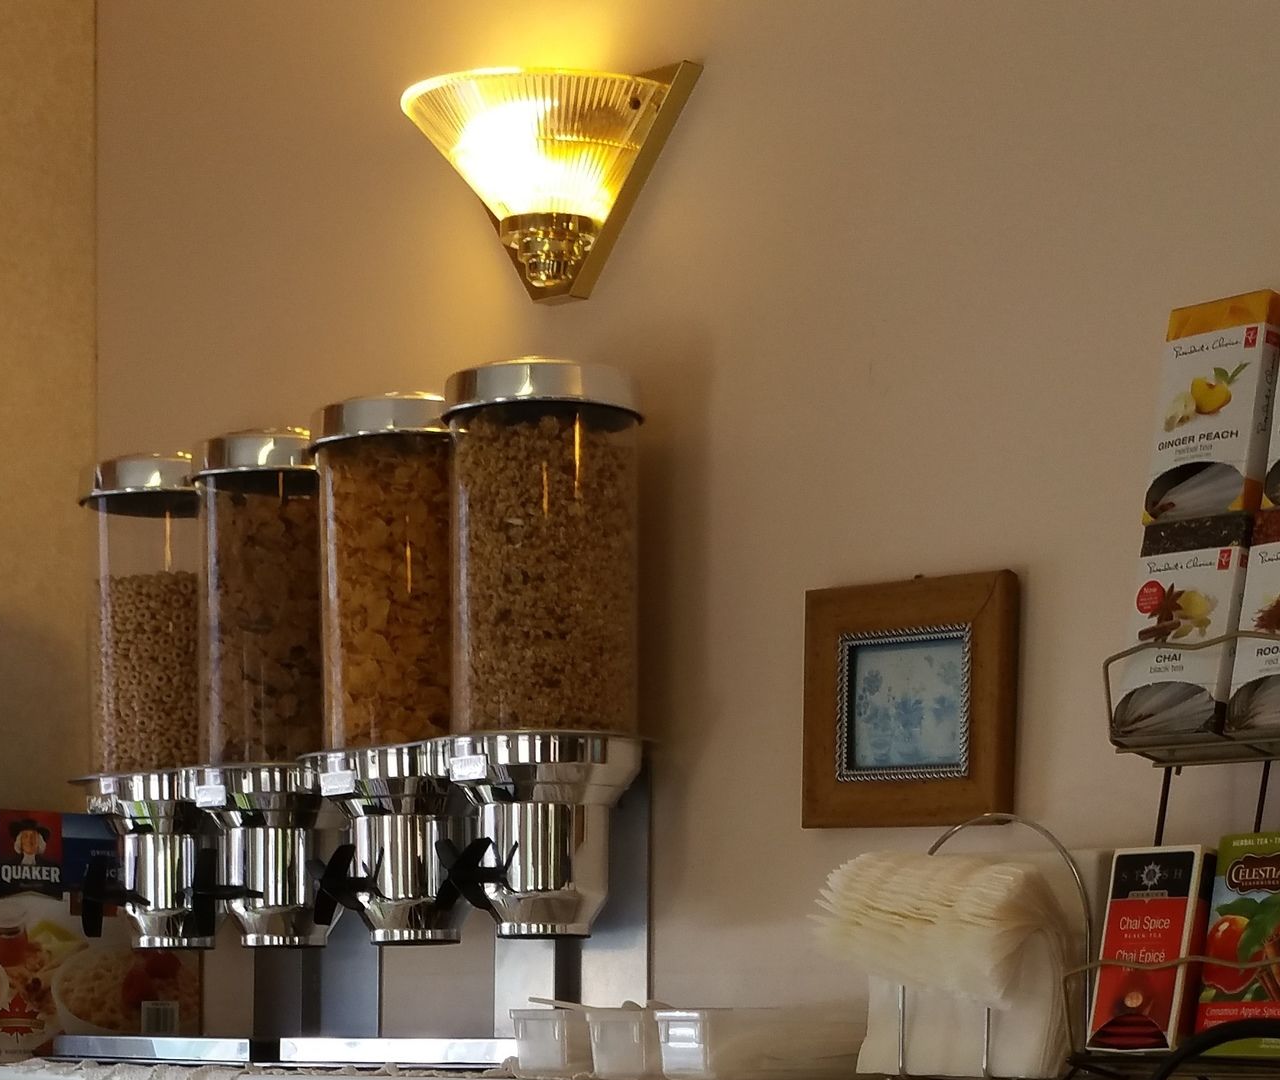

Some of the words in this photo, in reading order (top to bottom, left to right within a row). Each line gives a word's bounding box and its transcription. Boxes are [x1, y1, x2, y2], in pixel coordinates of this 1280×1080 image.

[1157, 435, 1196, 452] GINGER
[1198, 430, 1239, 443] PEACH
[1155, 653, 1182, 664] CHAI
[1232, 838, 1255, 847] HERBAL
[0, 864, 61, 883] QUAKER
[1119, 916, 1141, 930] Chai
[1142, 915, 1171, 932] Spice
[1115, 949, 1137, 962] Chai
[1205, 1007, 1239, 1016] Cinnamon
[1240, 1006, 1262, 1018] Apple
